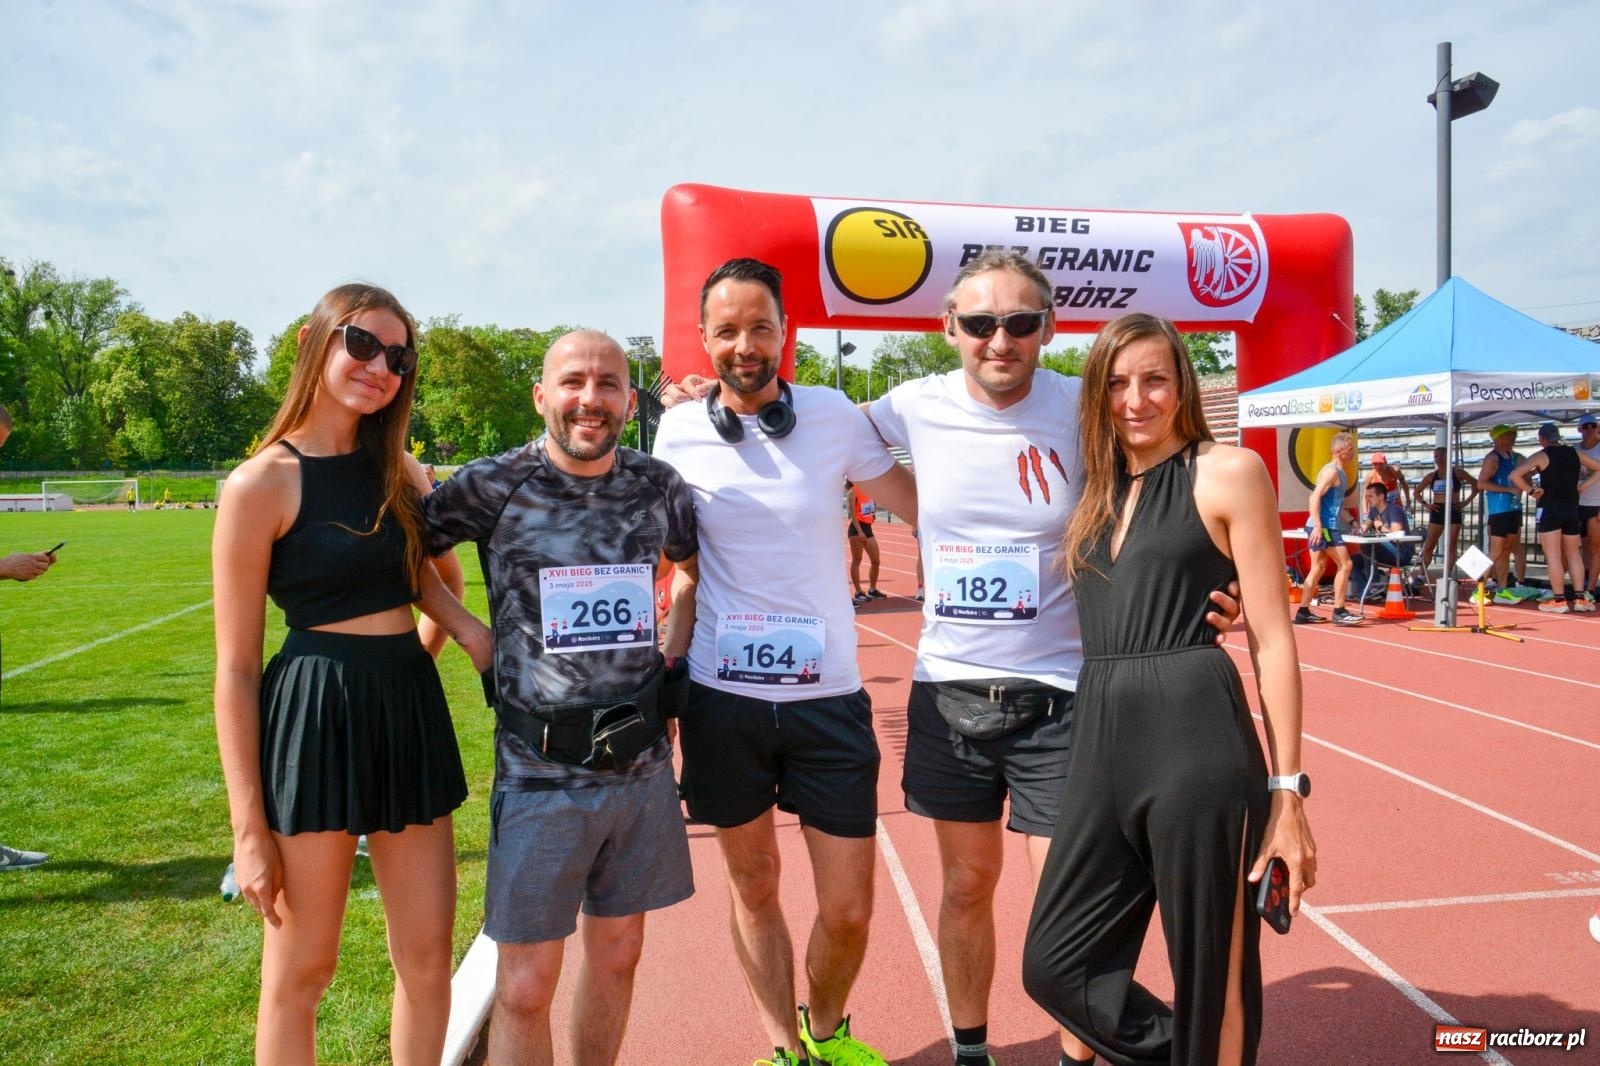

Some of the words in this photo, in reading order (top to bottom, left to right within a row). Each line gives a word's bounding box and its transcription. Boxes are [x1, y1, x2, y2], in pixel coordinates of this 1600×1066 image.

[1014, 215, 1090, 235] BIEG
[1037, 246, 1155, 273] GRANIC
[1469, 381, 1569, 401] PersonalBest
[1248, 399, 1315, 418] PersonalBest
[939, 544, 954, 553] XVII
[955, 545, 975, 554] BIEG
[975, 545, 992, 554] BEZ
[994, 545, 1031, 554] GRANIC
[549, 569, 568, 578] XVII
[570, 567, 592, 577] BIEG
[594, 566, 612, 576] BEZ
[613, 566, 645, 575] GRANIC
[555, 582, 574, 590] maja
[576, 580, 593, 588] 2025
[956, 576, 1008, 603] 182
[571, 598, 632, 628] 266
[744, 614, 765, 622] BIEG
[766, 615, 783, 623] BEZ
[784, 616, 818, 625] GRANIC
[730, 624, 747, 632] maja
[742, 643, 796, 670] 164
